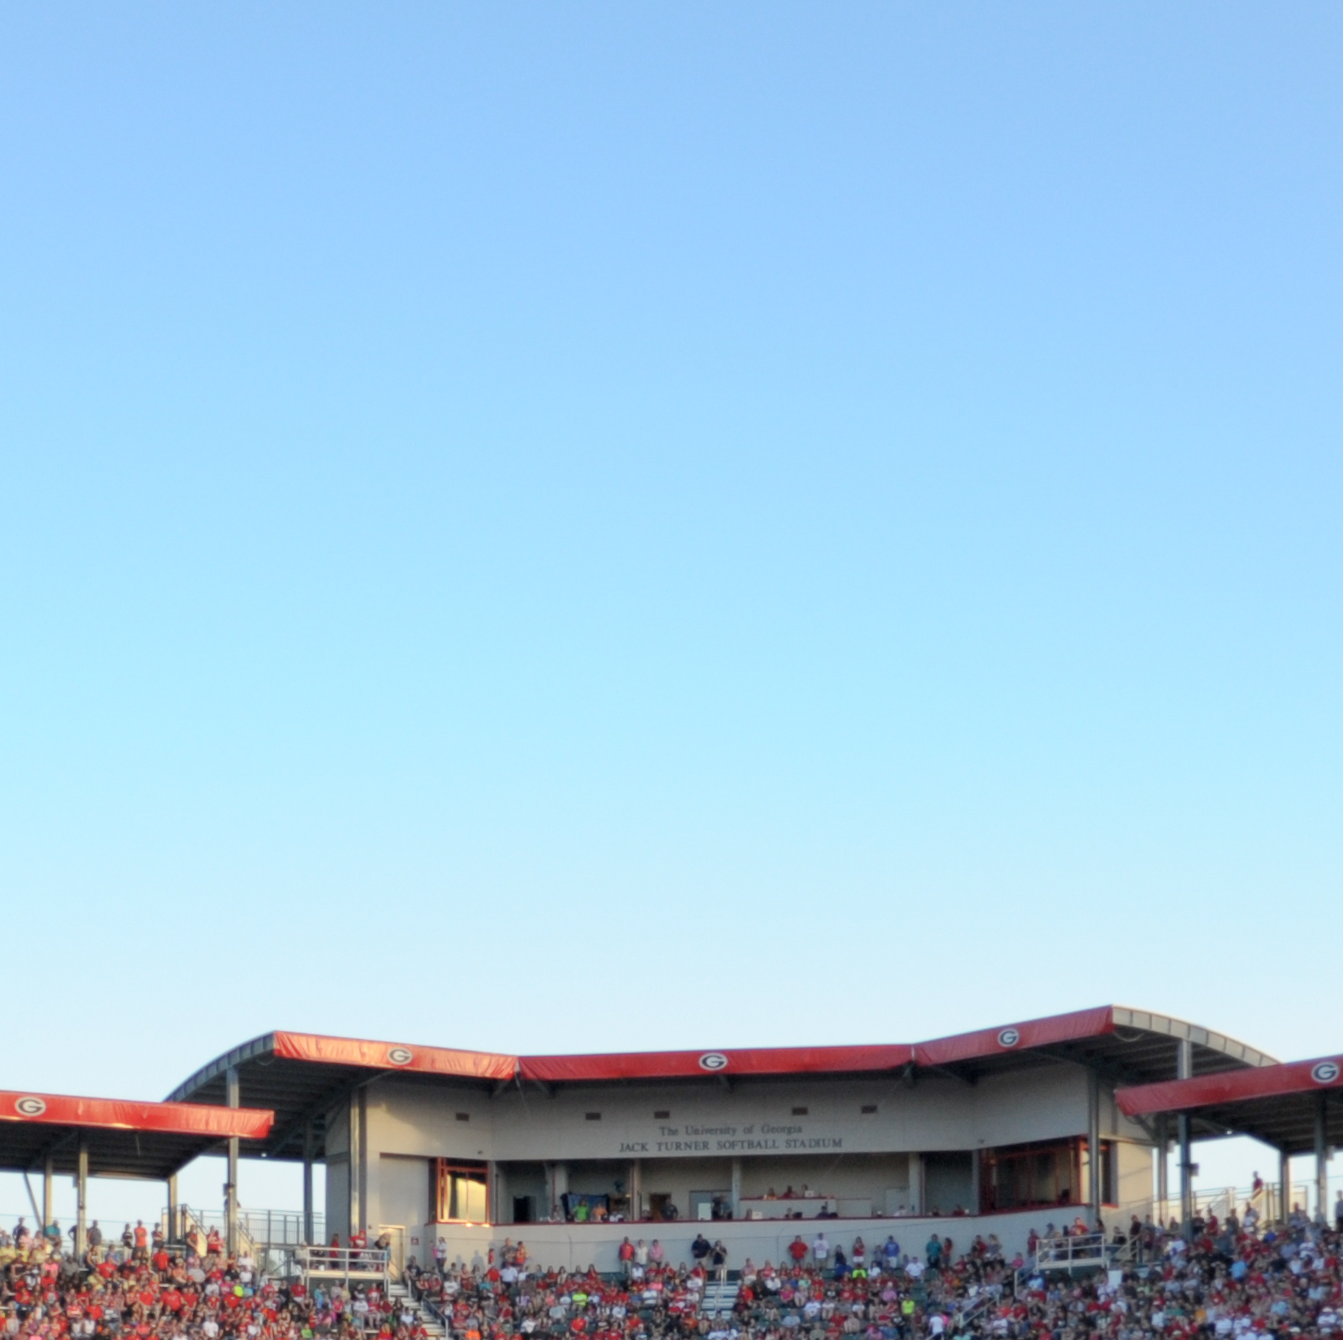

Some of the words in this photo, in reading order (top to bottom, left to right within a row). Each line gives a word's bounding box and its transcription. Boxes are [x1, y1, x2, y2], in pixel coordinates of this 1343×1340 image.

[659, 1126, 679, 1136] The
[685, 1125, 736, 1137] University
[743, 1125, 755, 1134] of
[761, 1124, 802, 1135] Georgia
[619, 1142, 648, 1152] JACK
[656, 1140, 709, 1152] TURNER
[717, 1139, 779, 1150] SOFTBALL
[785, 1138, 842, 1149] STADIUM
